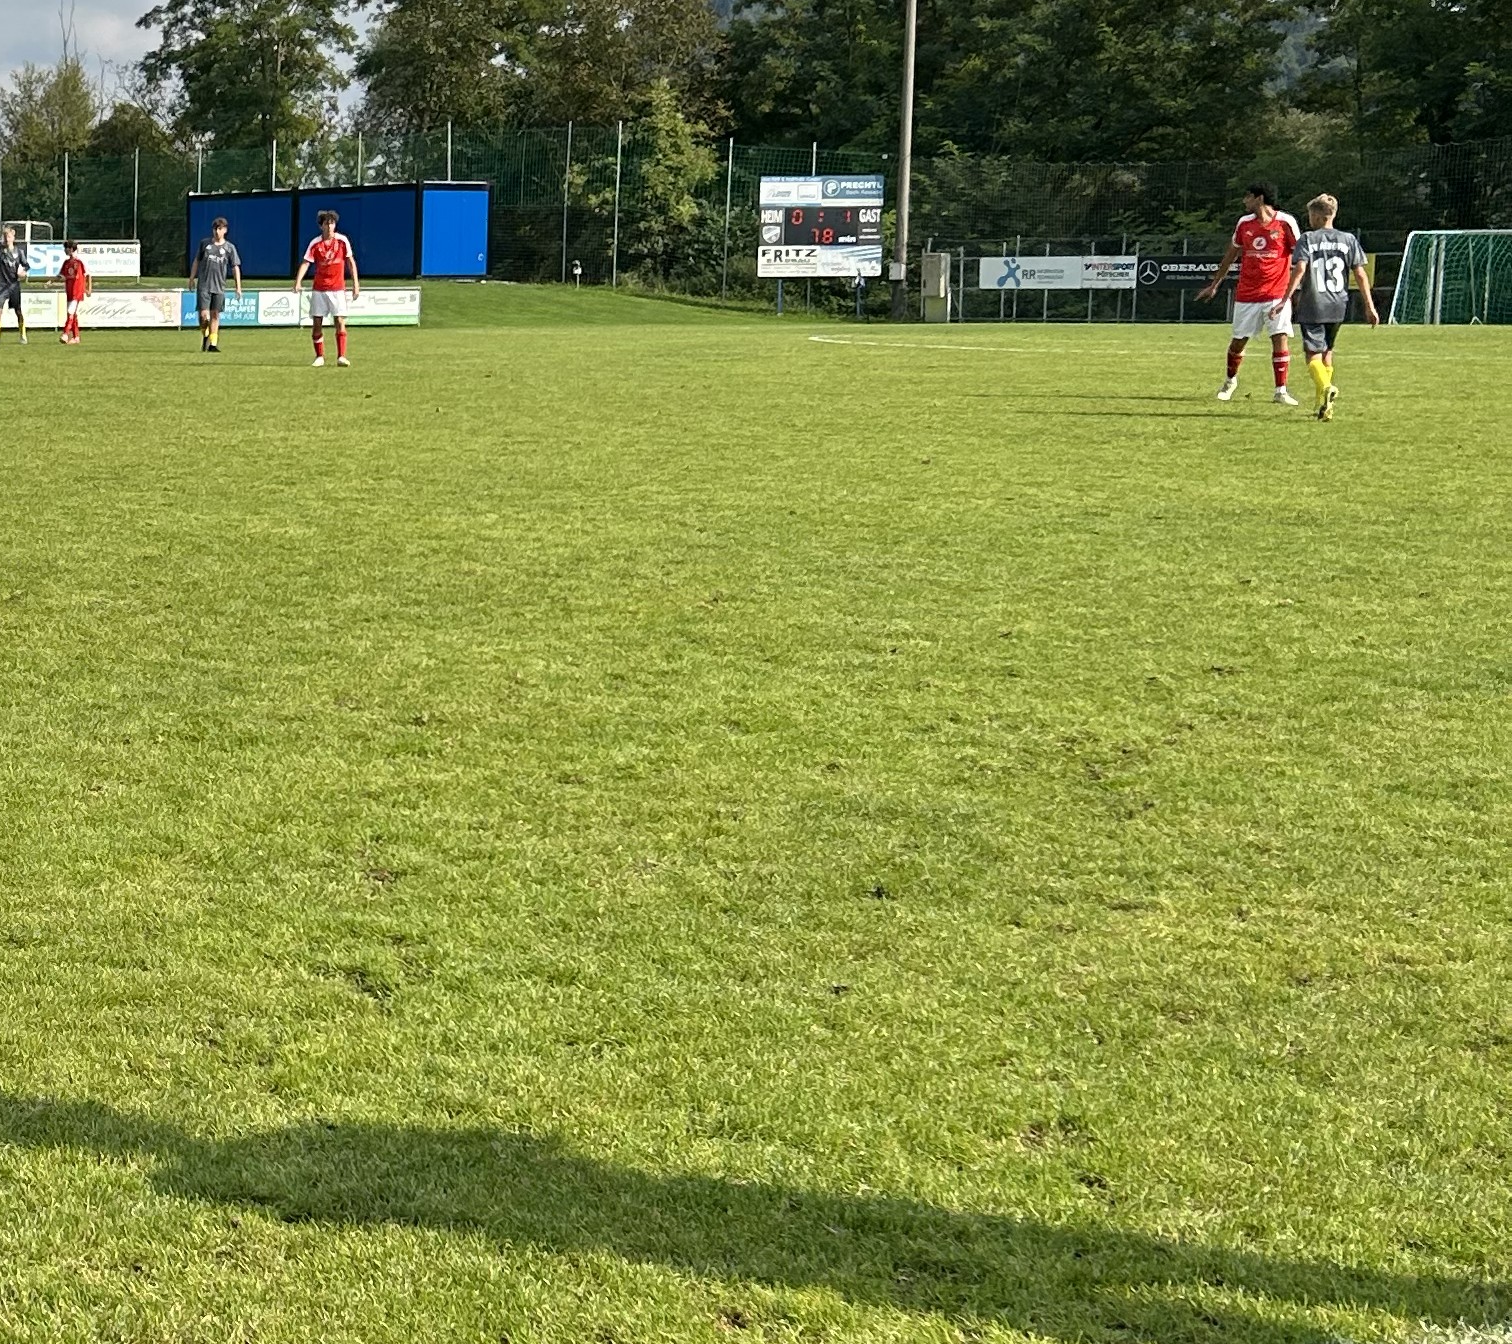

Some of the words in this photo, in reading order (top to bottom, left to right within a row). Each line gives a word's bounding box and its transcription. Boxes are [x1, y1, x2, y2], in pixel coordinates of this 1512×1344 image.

[761, 210, 783, 223] HEIM
[859, 209, 881, 223] GAST
[761, 248, 817, 263] FRITZ
[1161, 263, 1241, 272] OBERAIGE
[1313, 256, 1345, 293] 13
